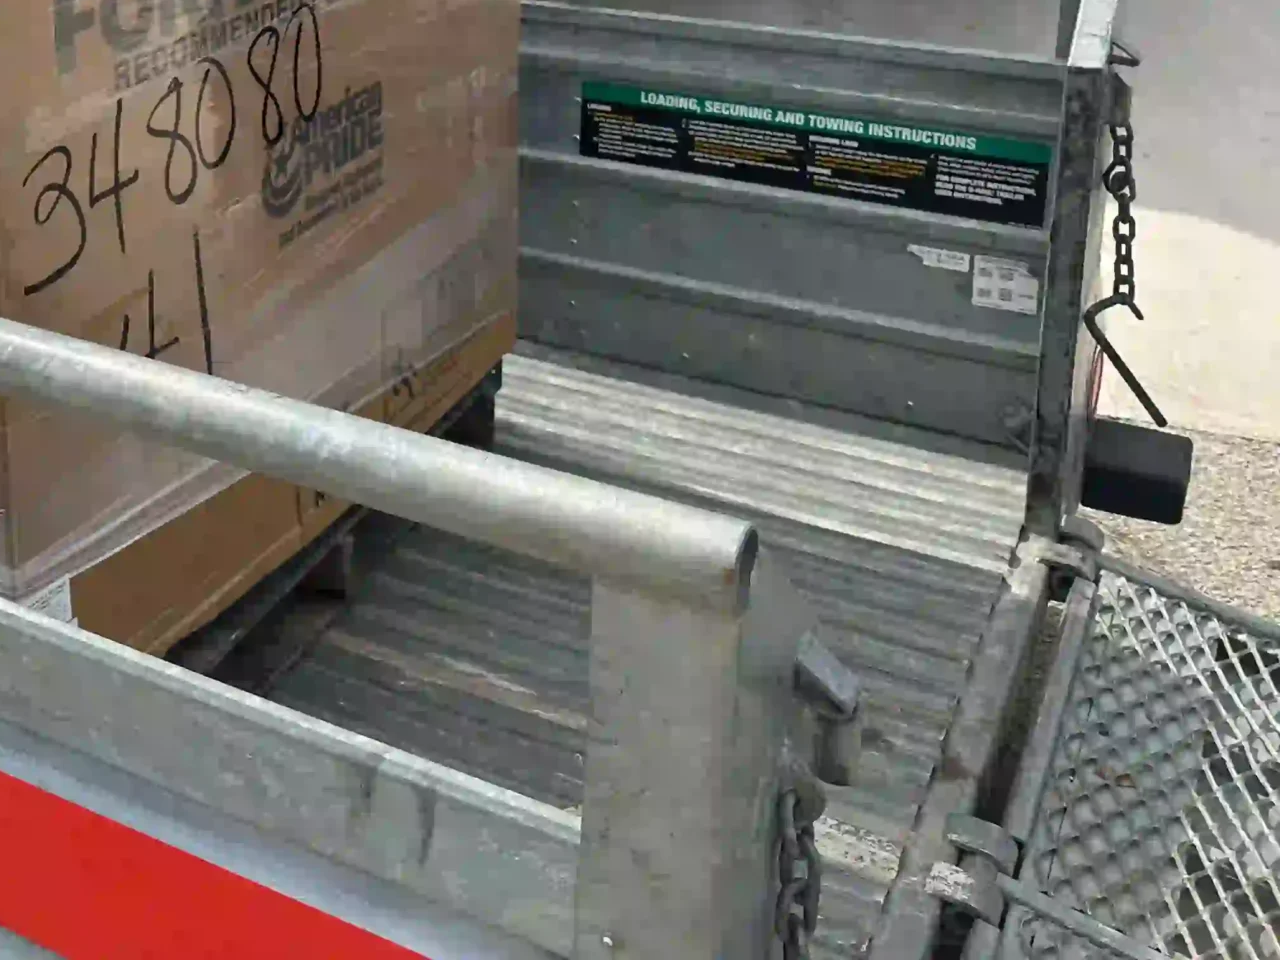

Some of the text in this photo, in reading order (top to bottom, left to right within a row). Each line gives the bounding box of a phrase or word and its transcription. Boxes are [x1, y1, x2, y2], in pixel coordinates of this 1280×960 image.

[640, 92, 977, 150] LOADING, SECURING AND TOWING INSTRUCTIONS
